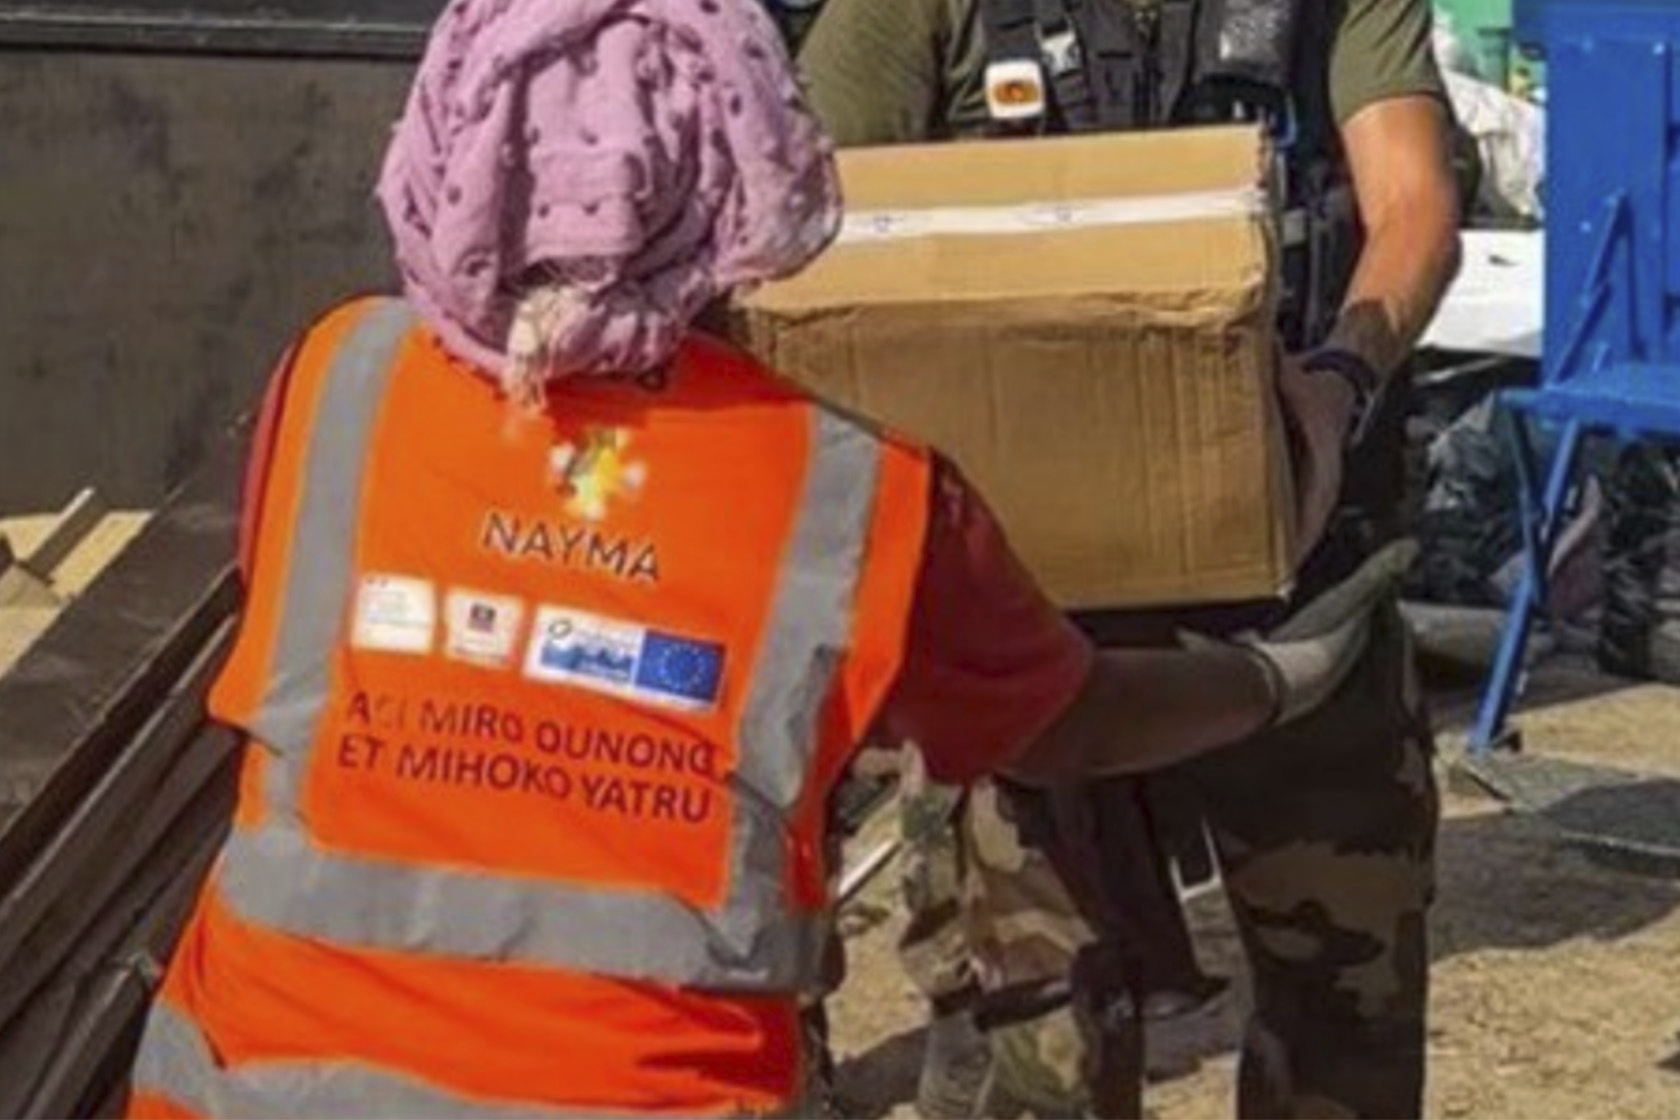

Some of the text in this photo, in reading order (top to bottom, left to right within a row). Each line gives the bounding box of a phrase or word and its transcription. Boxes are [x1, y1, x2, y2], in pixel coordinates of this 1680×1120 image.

[483, 511, 660, 582] NAYMA
[419, 697, 524, 744] MIRO
[337, 733, 711, 824] ET MIHOKO YATRU
